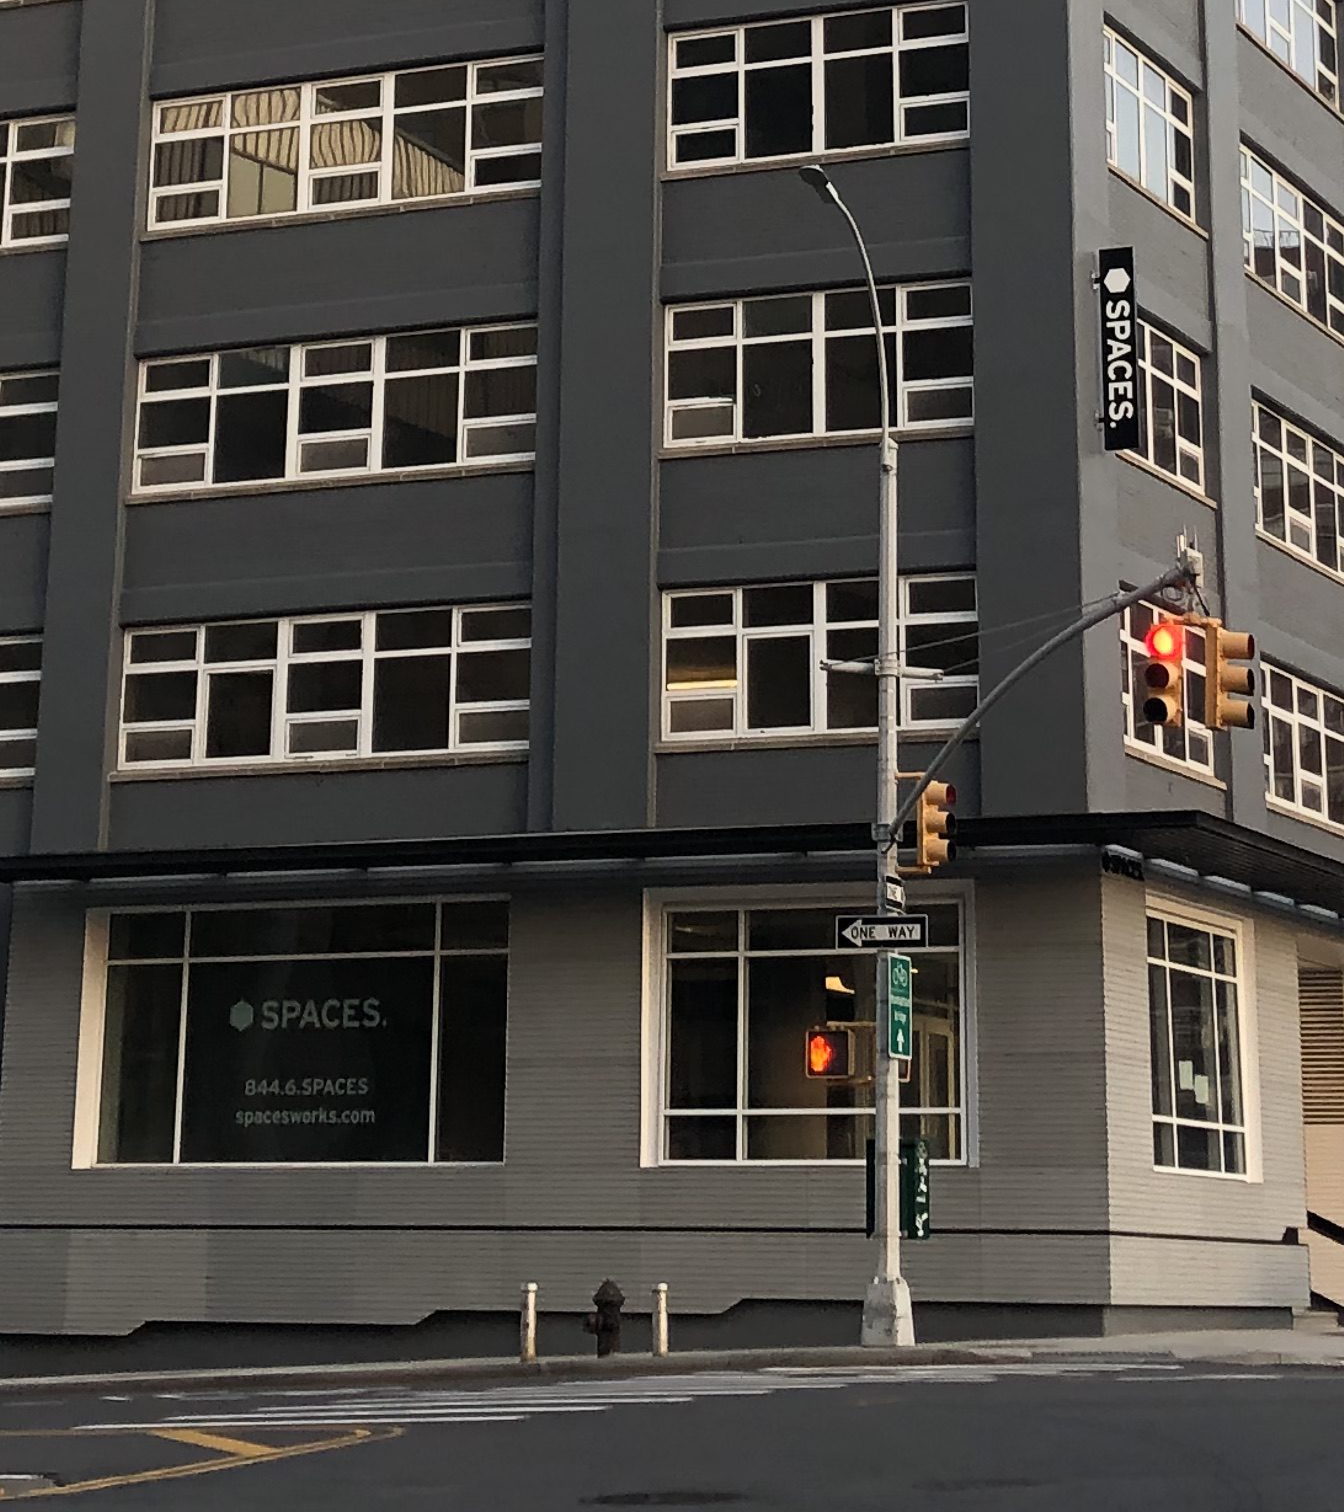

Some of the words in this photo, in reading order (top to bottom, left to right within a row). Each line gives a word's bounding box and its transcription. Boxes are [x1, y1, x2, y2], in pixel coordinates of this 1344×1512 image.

[1105, 299, 1135, 429] SPACES.
[850, 925, 876, 940] ONE
[887, 925, 916, 939] WAY
[261, 997, 388, 1030] SPACES.
[244, 1077, 370, 1096] 844.6.SPACES
[235, 1106, 377, 1128] spacesworks.com
